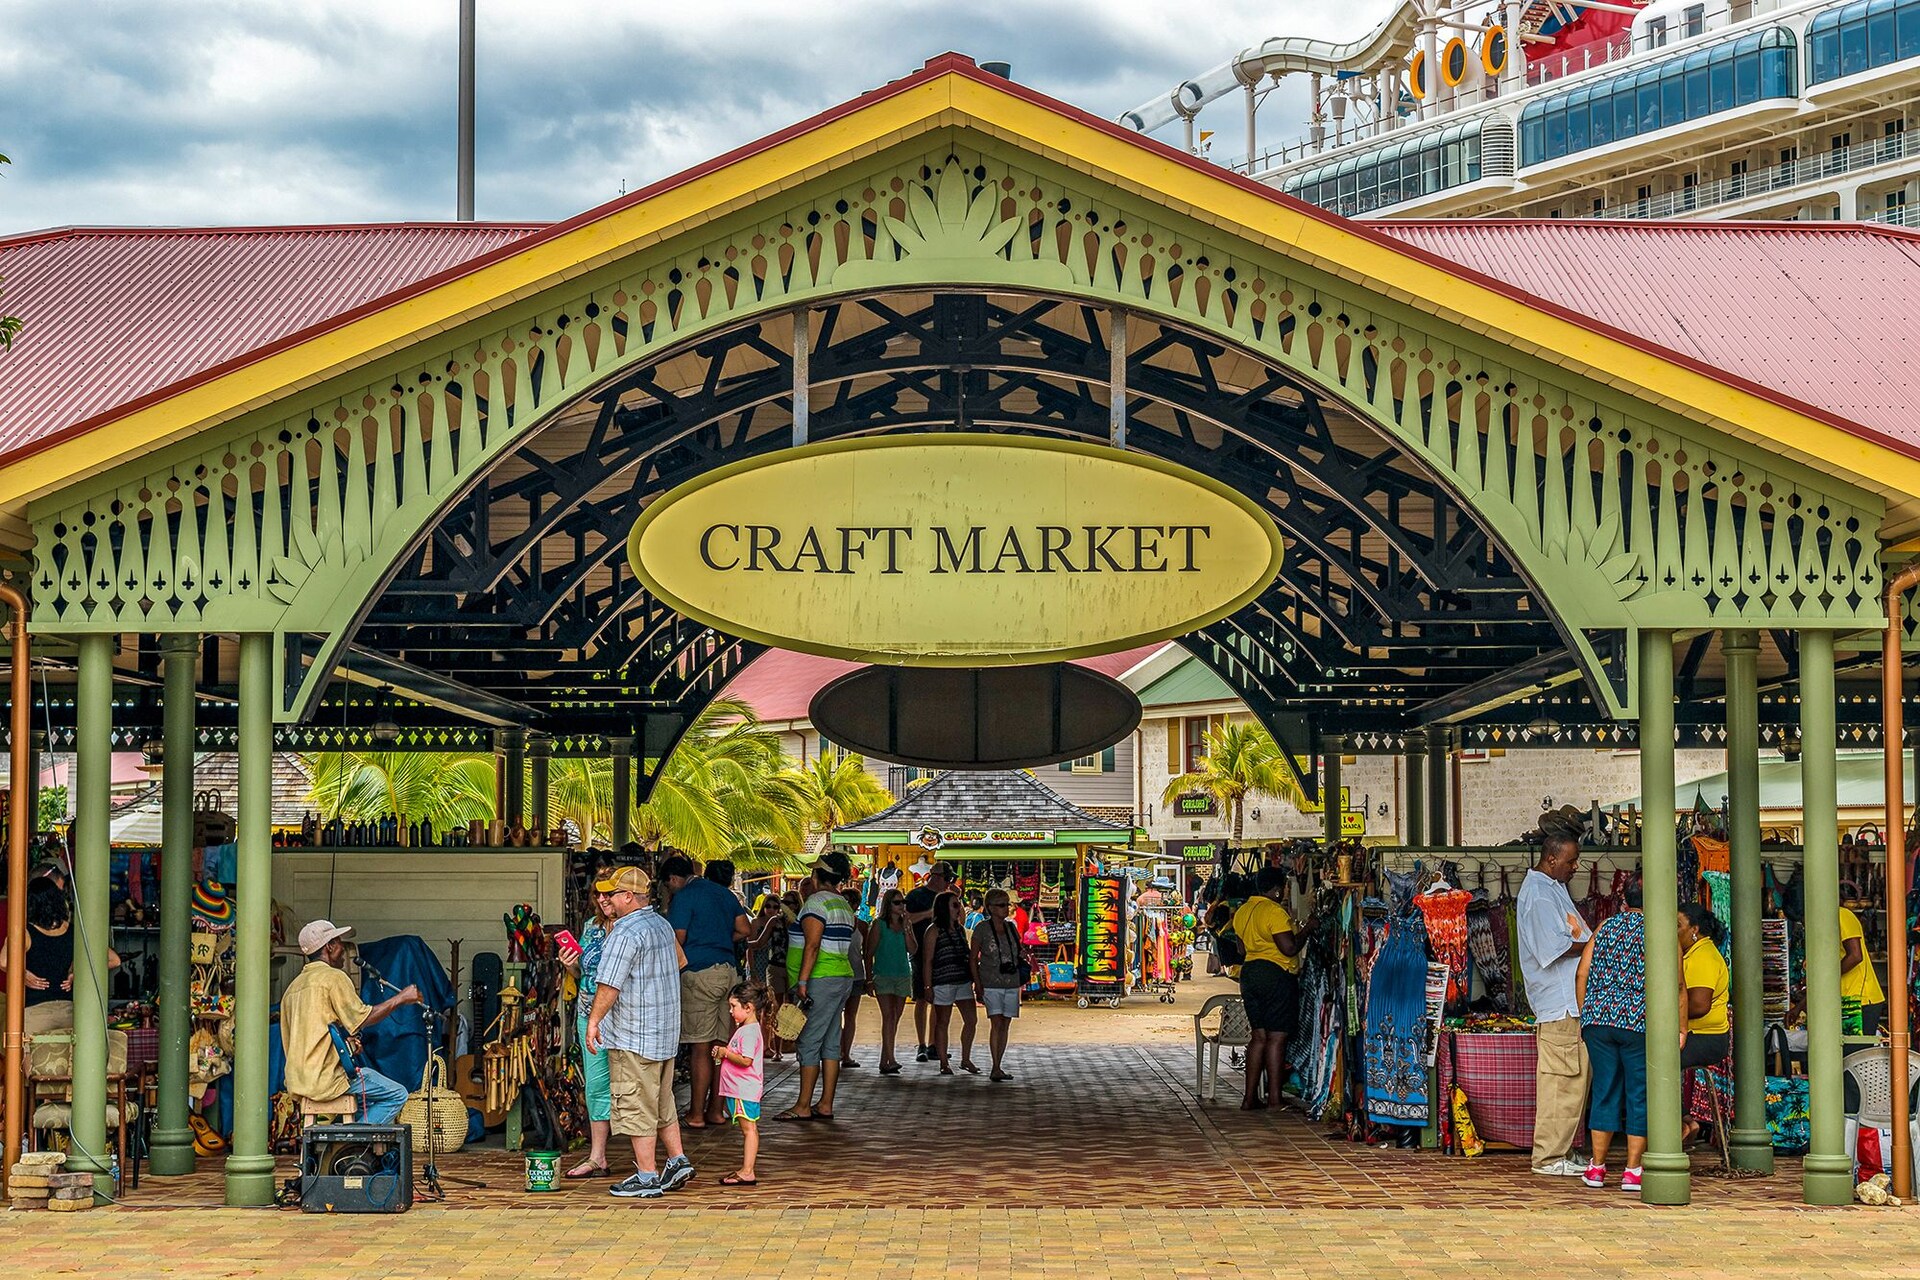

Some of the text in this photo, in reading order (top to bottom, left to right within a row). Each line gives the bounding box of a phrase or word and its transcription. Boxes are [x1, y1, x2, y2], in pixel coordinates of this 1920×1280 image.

[699, 523, 1211, 574] CRAFT MARKET
[944, 832, 1046, 841] CHEAP CHARLIE
